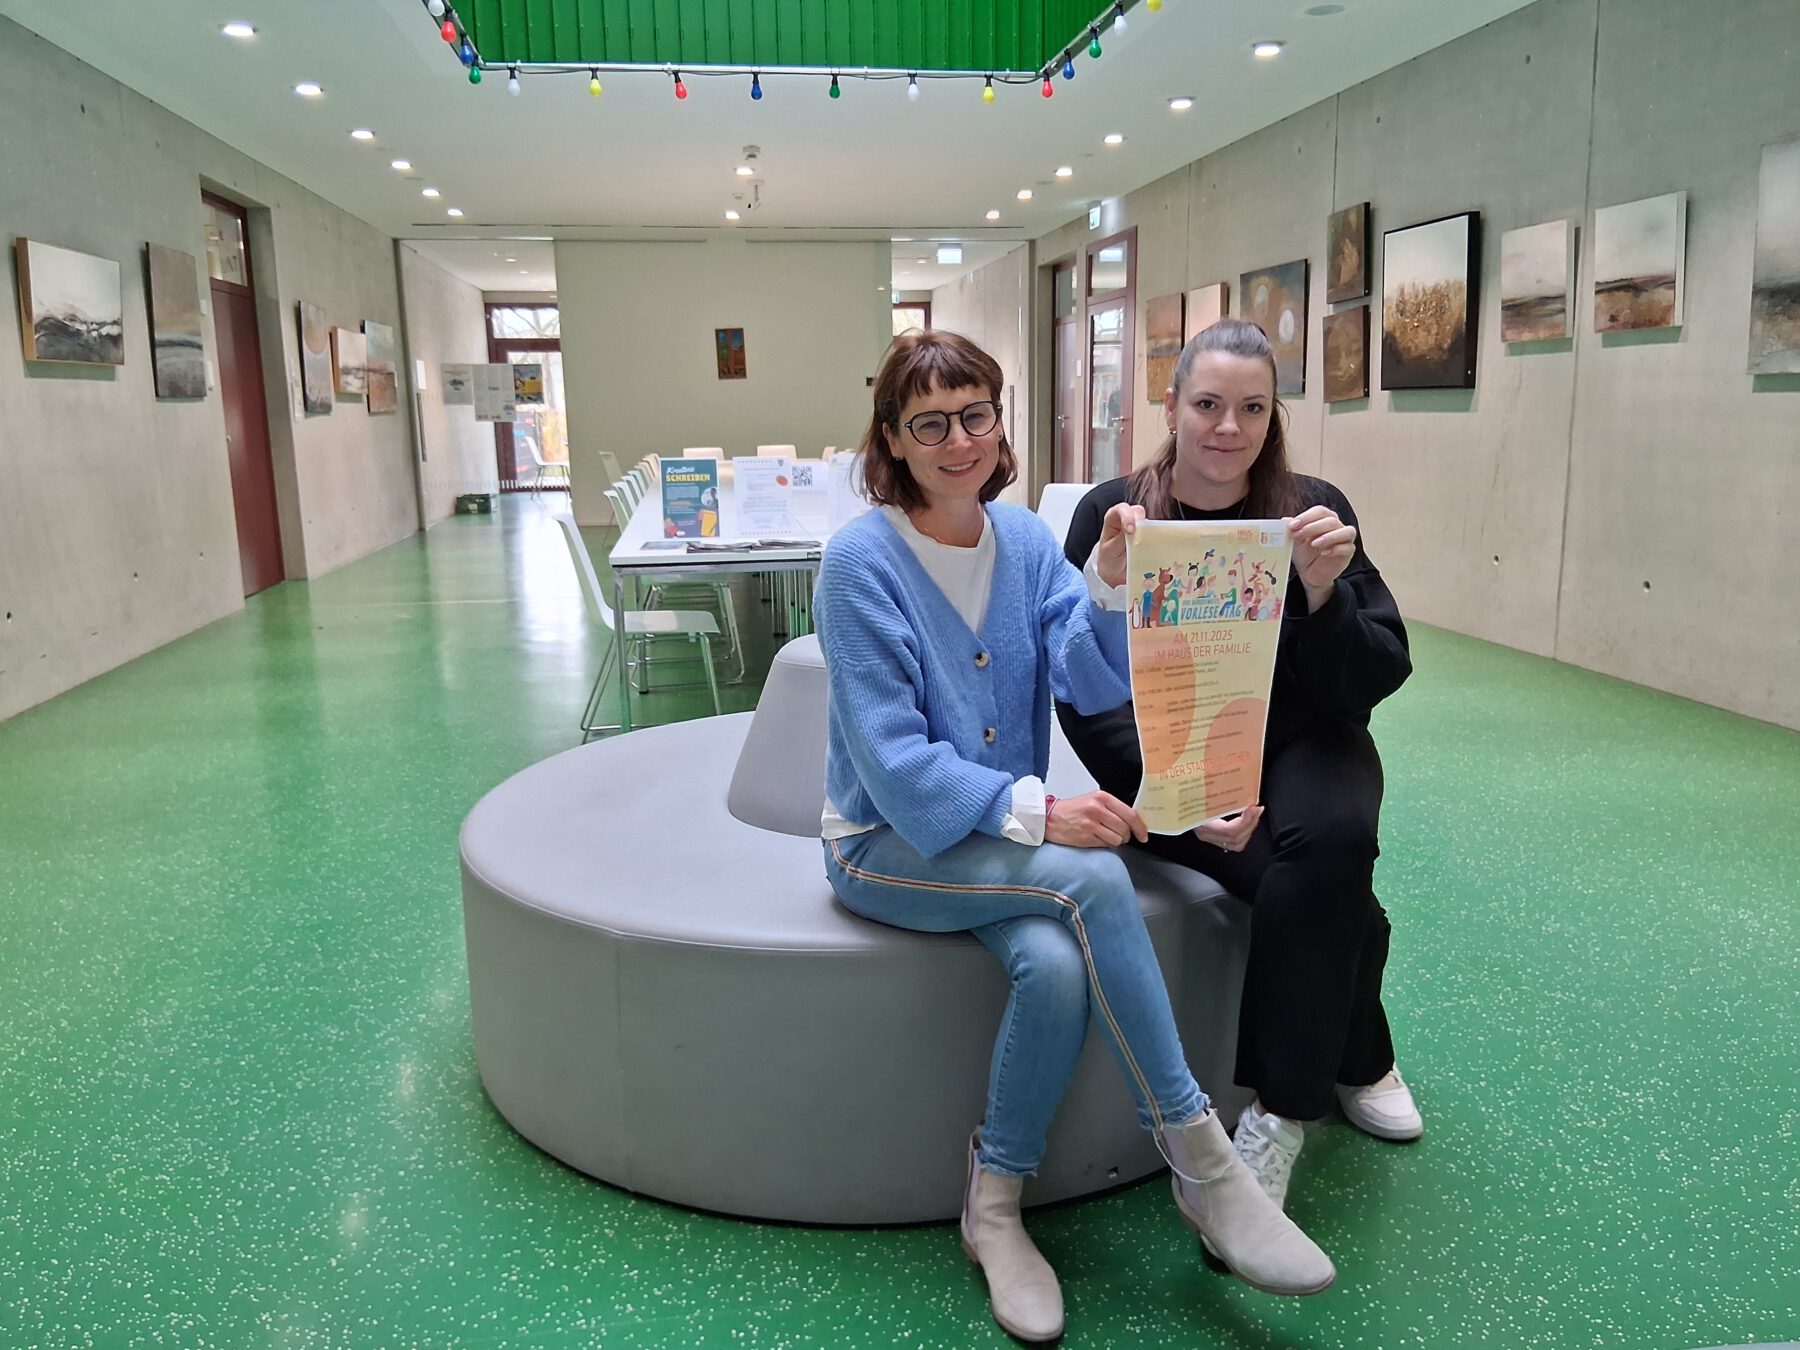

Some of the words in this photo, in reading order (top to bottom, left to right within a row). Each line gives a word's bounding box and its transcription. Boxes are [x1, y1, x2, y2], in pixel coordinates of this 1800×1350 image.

[665, 474, 711, 482] SCHREIBEN
[1174, 632, 1188, 645] AM
[1190, 630, 1233, 643] 21.11.2025
[1154, 650, 1166, 660] IM
[1167, 647, 1192, 660] HAUS
[1193, 645, 1211, 657] DER
[1213, 642, 1252, 655] FAMILIE
[1159, 768, 1169, 780] IN
[1169, 764, 1186, 778] DER
